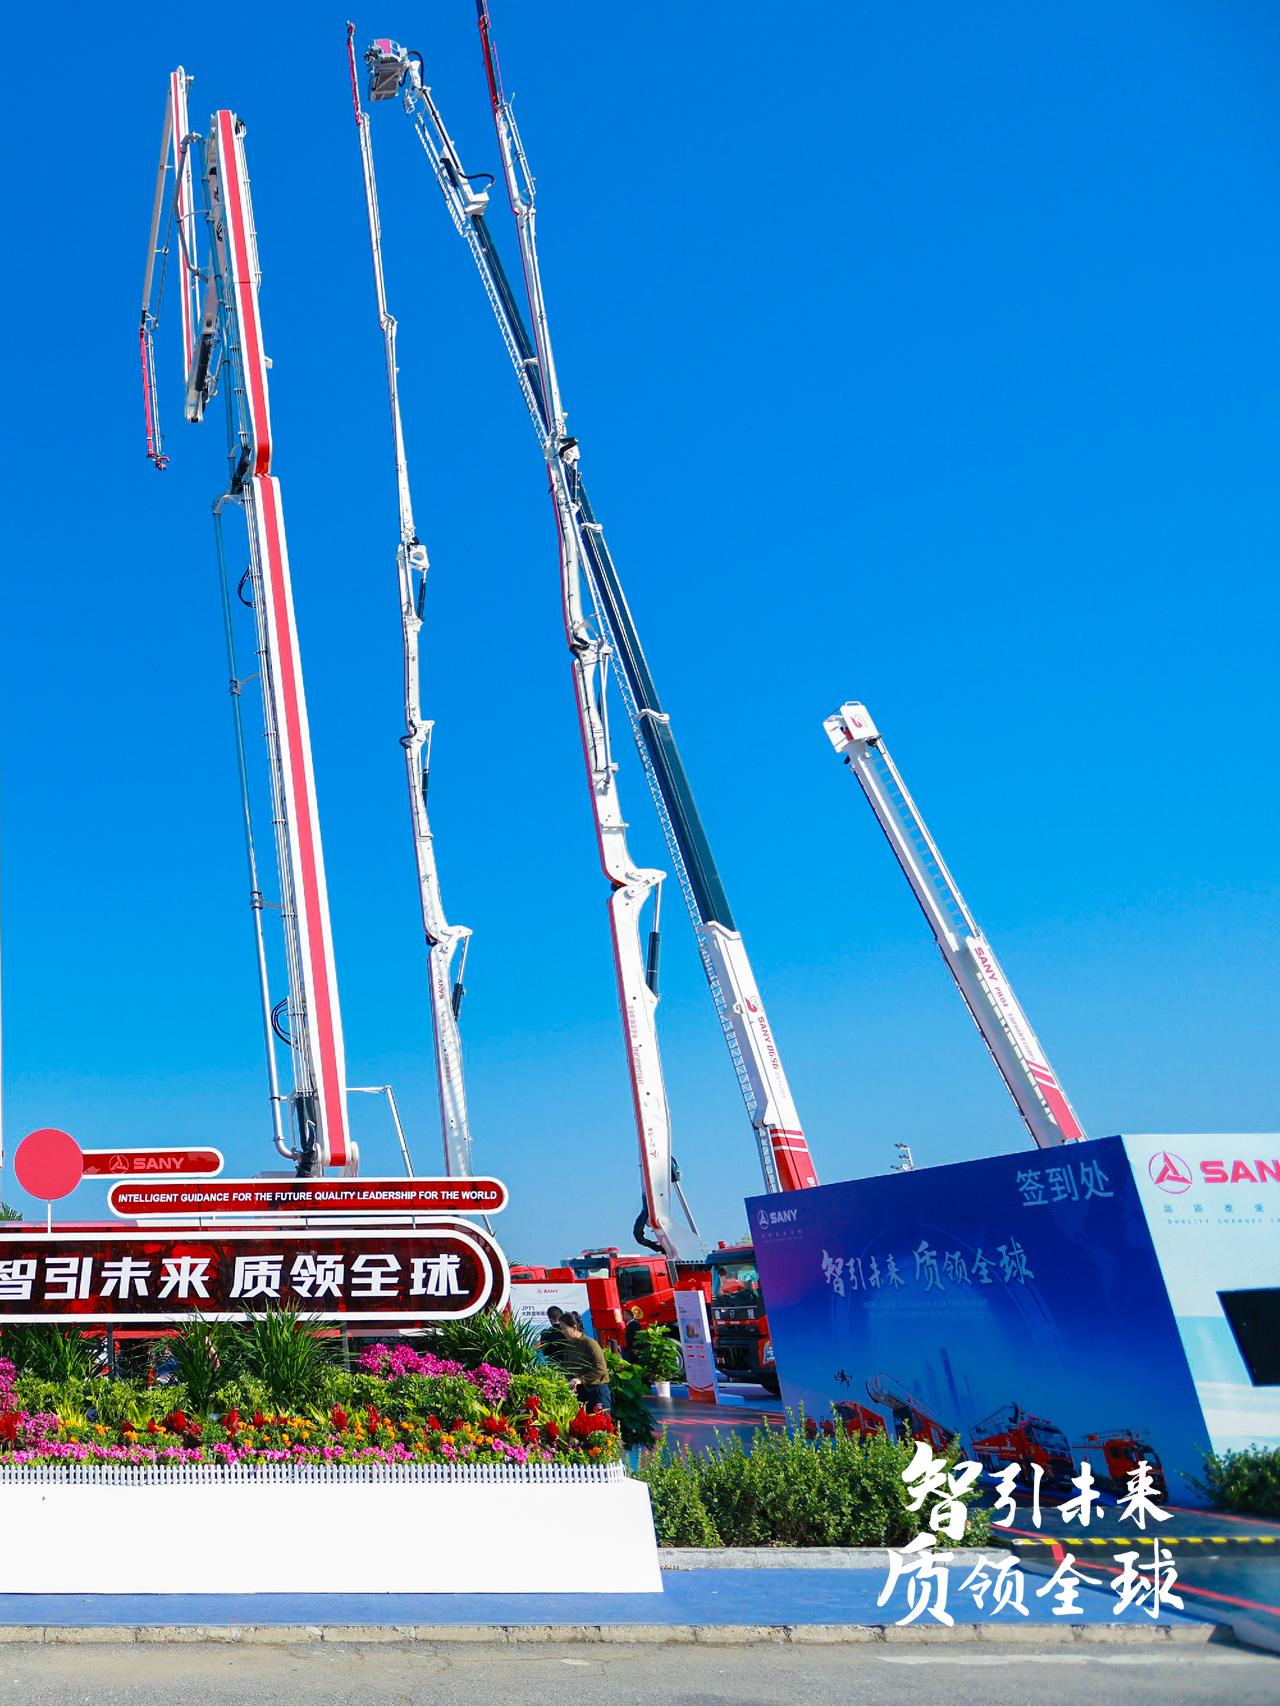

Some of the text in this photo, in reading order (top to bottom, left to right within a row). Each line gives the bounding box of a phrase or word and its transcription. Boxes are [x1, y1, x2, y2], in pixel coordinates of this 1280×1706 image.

[974, 947, 998, 982] SANY
[758, 1016, 771, 1043] SANY
[133, 1157, 185, 1171] SANY
[118, 1190, 498, 1203] INTELLIGENT GUIDANCE FOR THE FUTURE QUALITY LEADERSHIP FOR THE WORLD
[1016, 1159, 1115, 1208] 签到处
[769, 1208, 798, 1225] SANY
[229, 1254, 470, 1298] 质领全球
[820, 1237, 1035, 1297] 智引未来 质领全球
